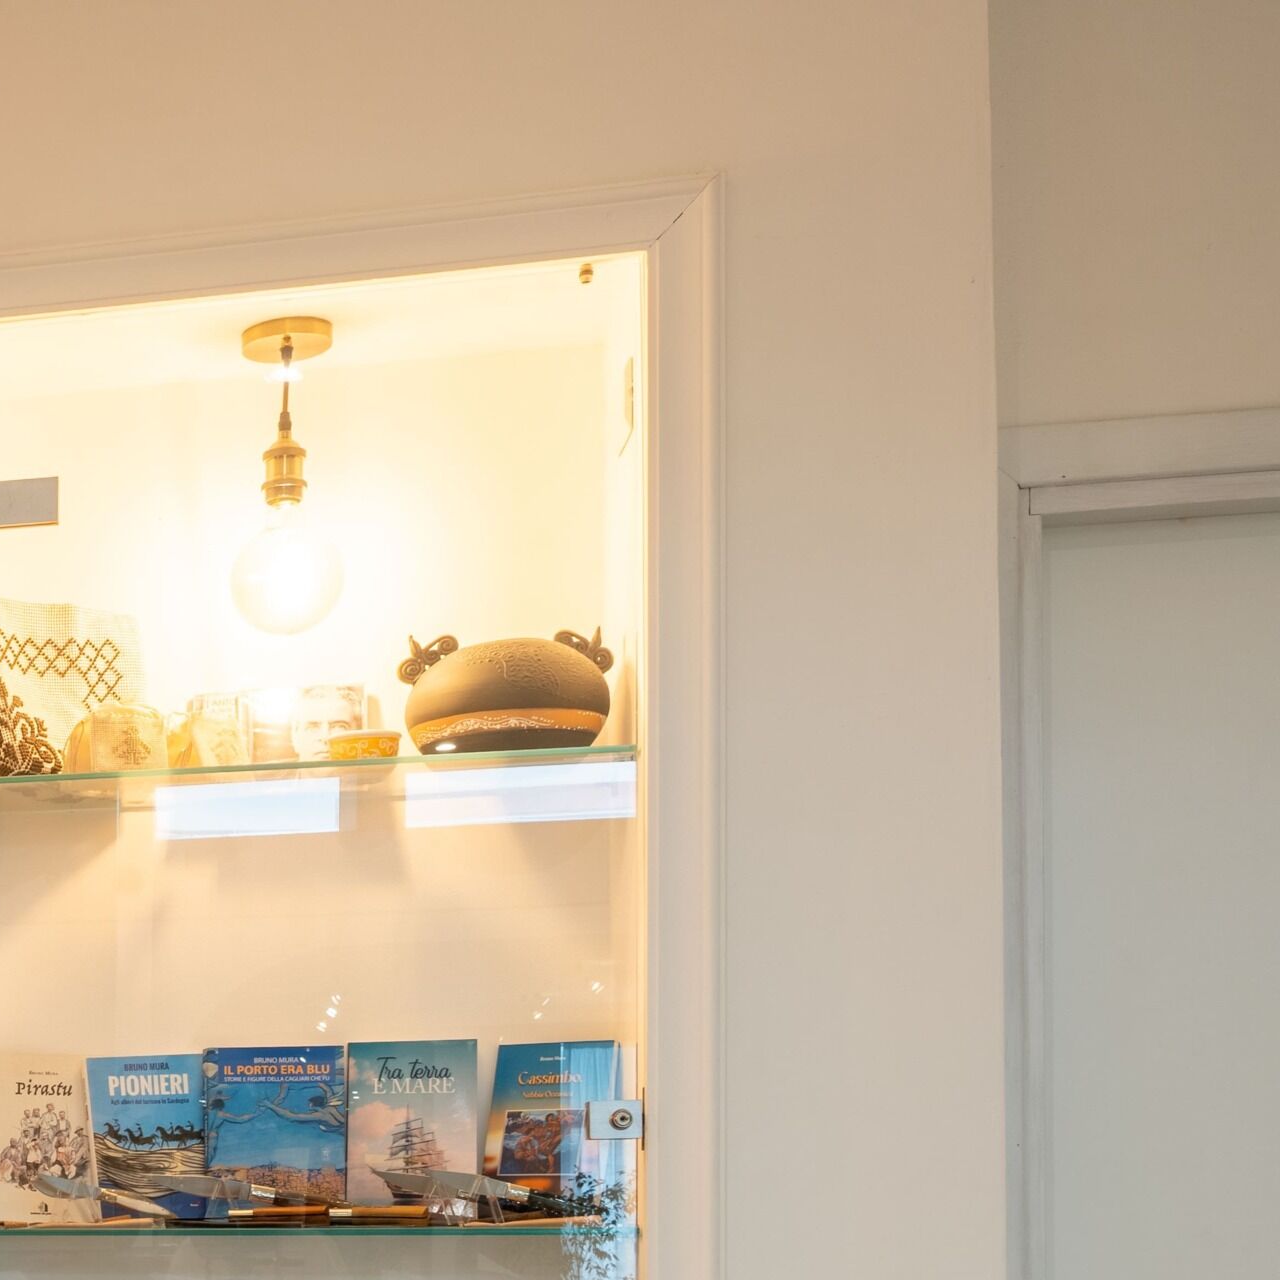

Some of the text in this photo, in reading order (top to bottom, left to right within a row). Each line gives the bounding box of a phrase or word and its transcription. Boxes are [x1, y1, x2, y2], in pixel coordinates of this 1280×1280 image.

[124, 1062, 170, 1072] BRUNO MURA
[223, 1064, 330, 1075] IL PORTO ERA BLU
[376, 1056, 452, 1082] Tra terra
[15, 1079, 73, 1097] Pirastu
[108, 1073, 190, 1097] PIONIERI
[372, 1076, 456, 1095] E MARE
